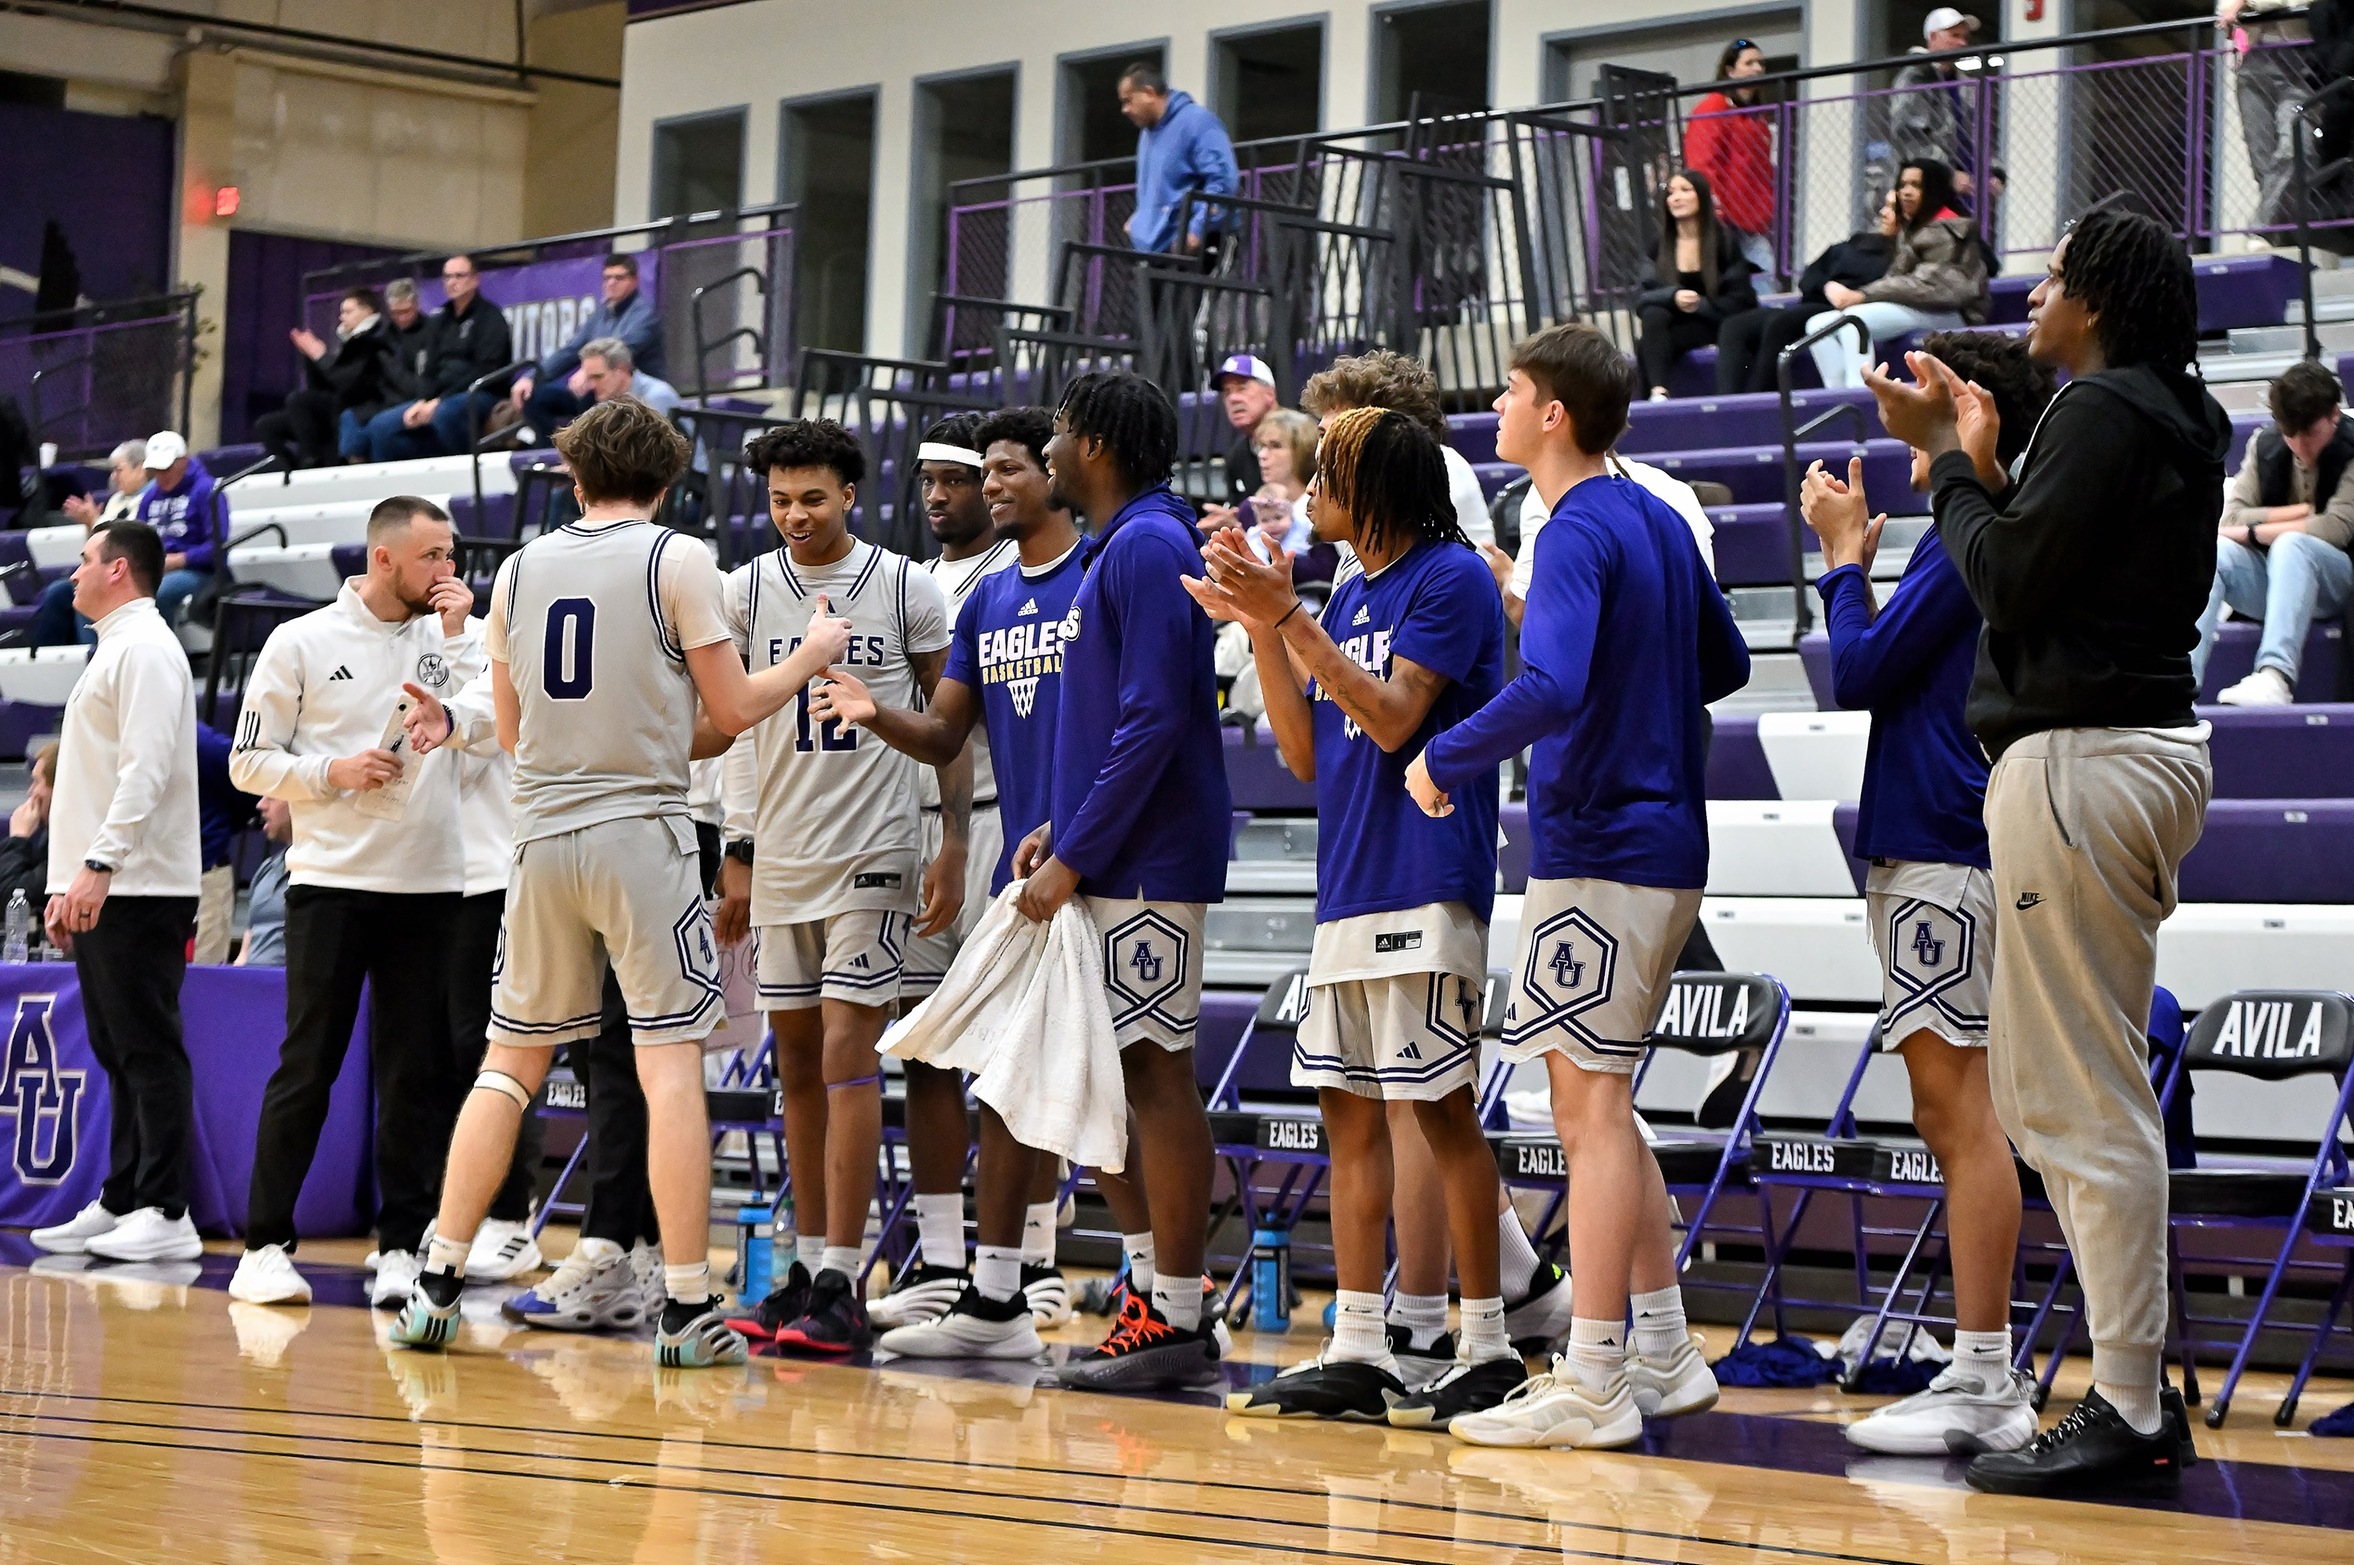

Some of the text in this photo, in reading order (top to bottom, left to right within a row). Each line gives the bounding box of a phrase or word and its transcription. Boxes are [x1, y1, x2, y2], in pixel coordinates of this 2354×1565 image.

[541, 595, 597, 702] 0
[982, 655, 1062, 685] BASKETBAL
[1128, 940, 1164, 983] AU
[1547, 940, 1587, 990] AU
[1910, 920, 1946, 968] AU
[1655, 984, 1750, 1038] AVILA
[2211, 1000, 2324, 1059] AVILA
[1269, 1121, 1318, 1149] EAGLES
[1518, 1146, 1567, 1176] EAGLE
[1771, 1141, 1834, 1173] EAGLES
[1891, 1150, 1945, 1183] EAGLE
